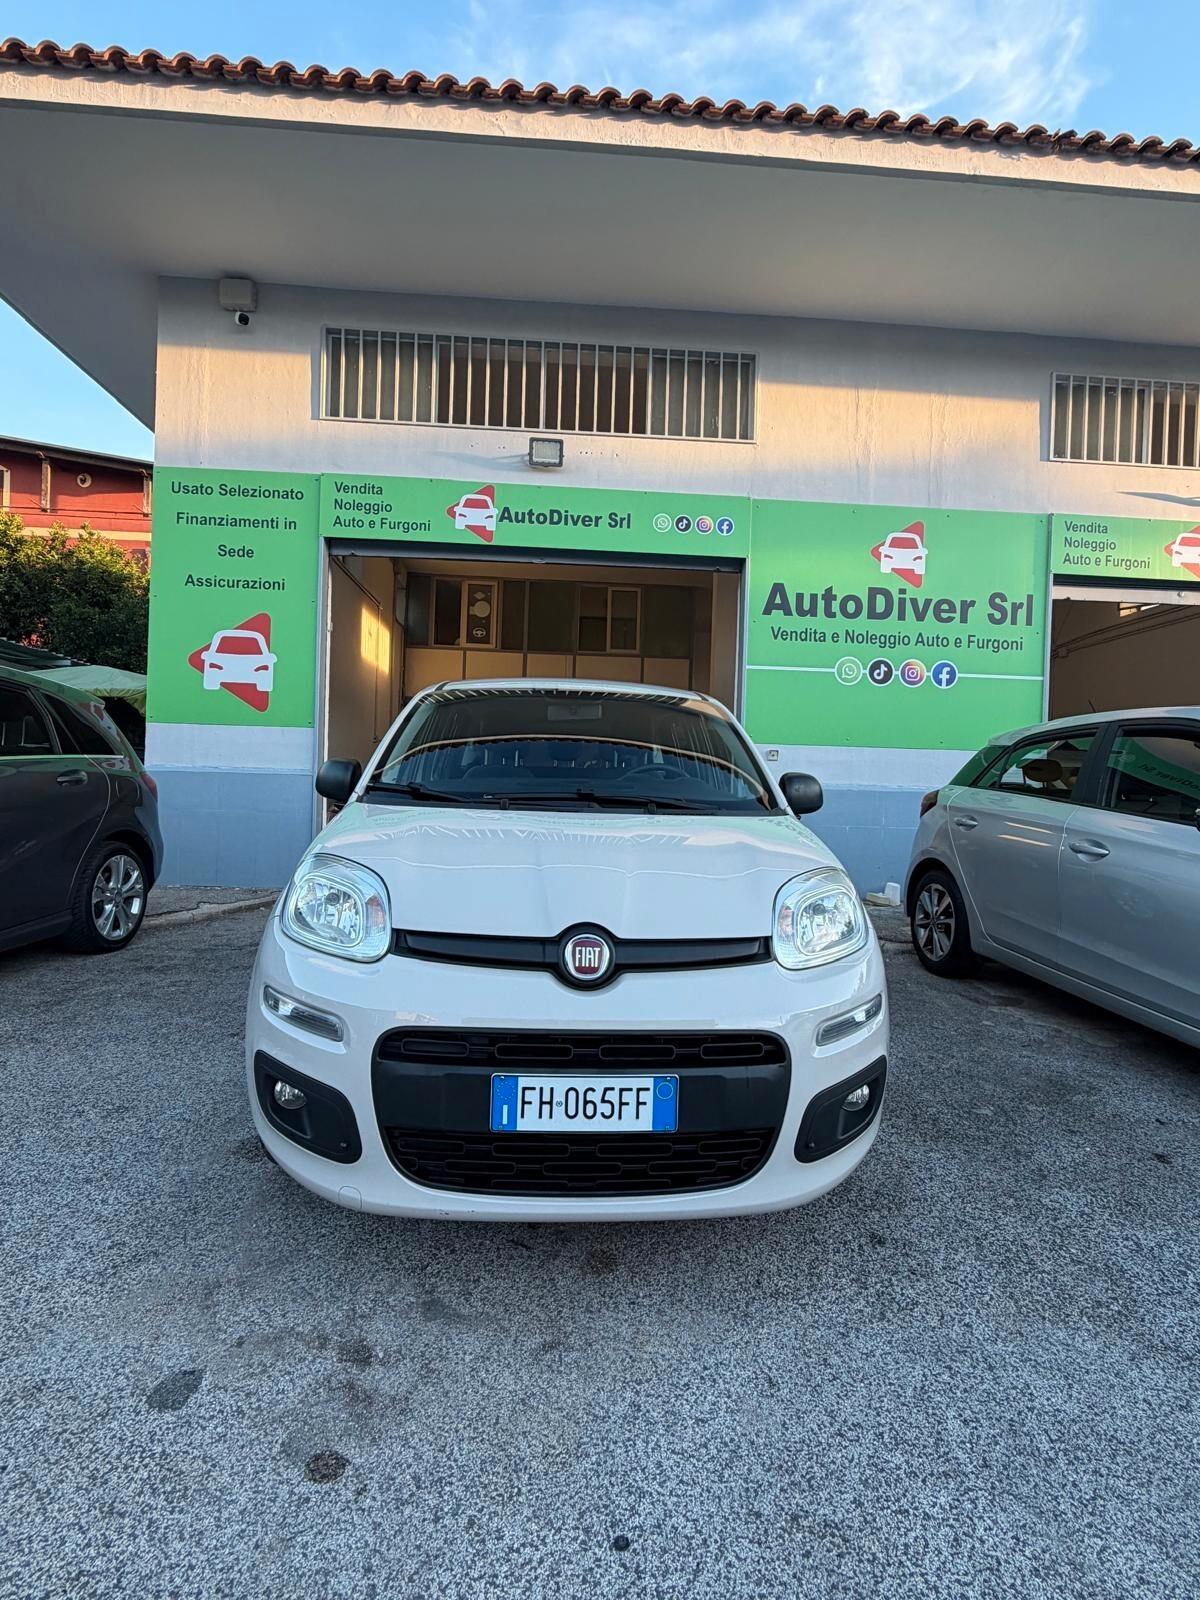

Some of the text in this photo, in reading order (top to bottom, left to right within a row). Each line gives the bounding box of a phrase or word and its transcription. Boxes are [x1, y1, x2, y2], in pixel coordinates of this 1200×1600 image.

[171, 480, 304, 501] Usato Selezionato
[334, 480, 383, 496] Vendita
[334, 498, 393, 516] Noleggio
[176, 511, 297, 530] Finanziamenti in
[332, 515, 431, 534] Auto e Furgoni
[498, 506, 631, 529] AutoDiver Srl
[1064, 520, 1108, 534] Vendita
[217, 544, 255, 559] Sede
[1063, 535, 1117, 553] Noleggio
[1062, 552, 1151, 571] Auto e Furgoni
[184, 573, 286, 591] Assicurazioni
[761, 581, 1034, 627] AutoDiver Srl
[770, 625, 1024, 654] Vendita e Noleggio Auto e Furgoni
[575, 946, 601, 968] FIAT
